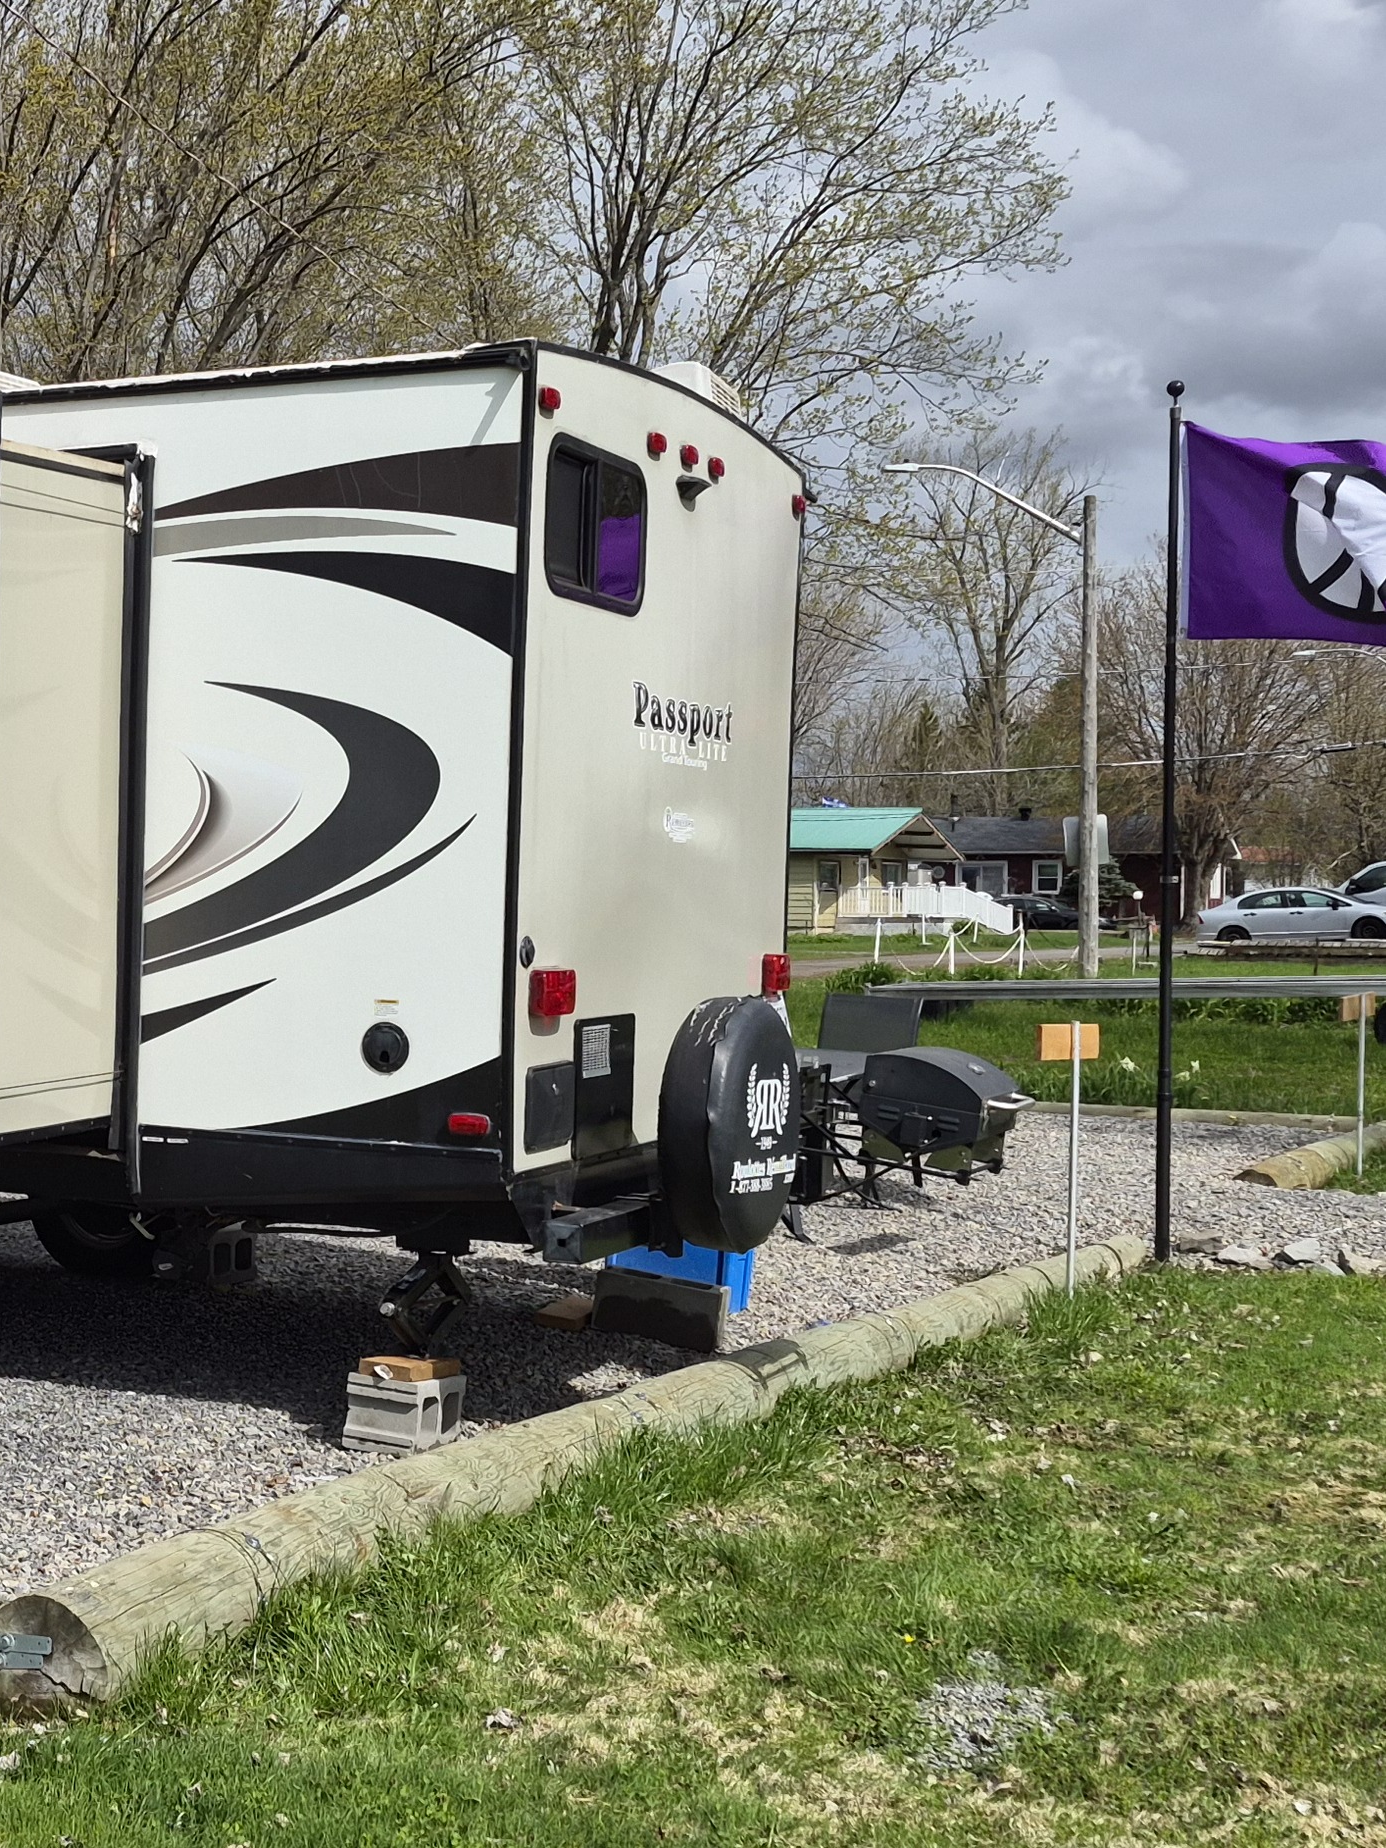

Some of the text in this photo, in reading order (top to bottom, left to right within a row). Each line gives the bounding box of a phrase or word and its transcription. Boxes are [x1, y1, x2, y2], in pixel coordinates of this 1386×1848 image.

[633, 680, 733, 747] Passport
[639, 732, 727, 761] ULTRA LITE
